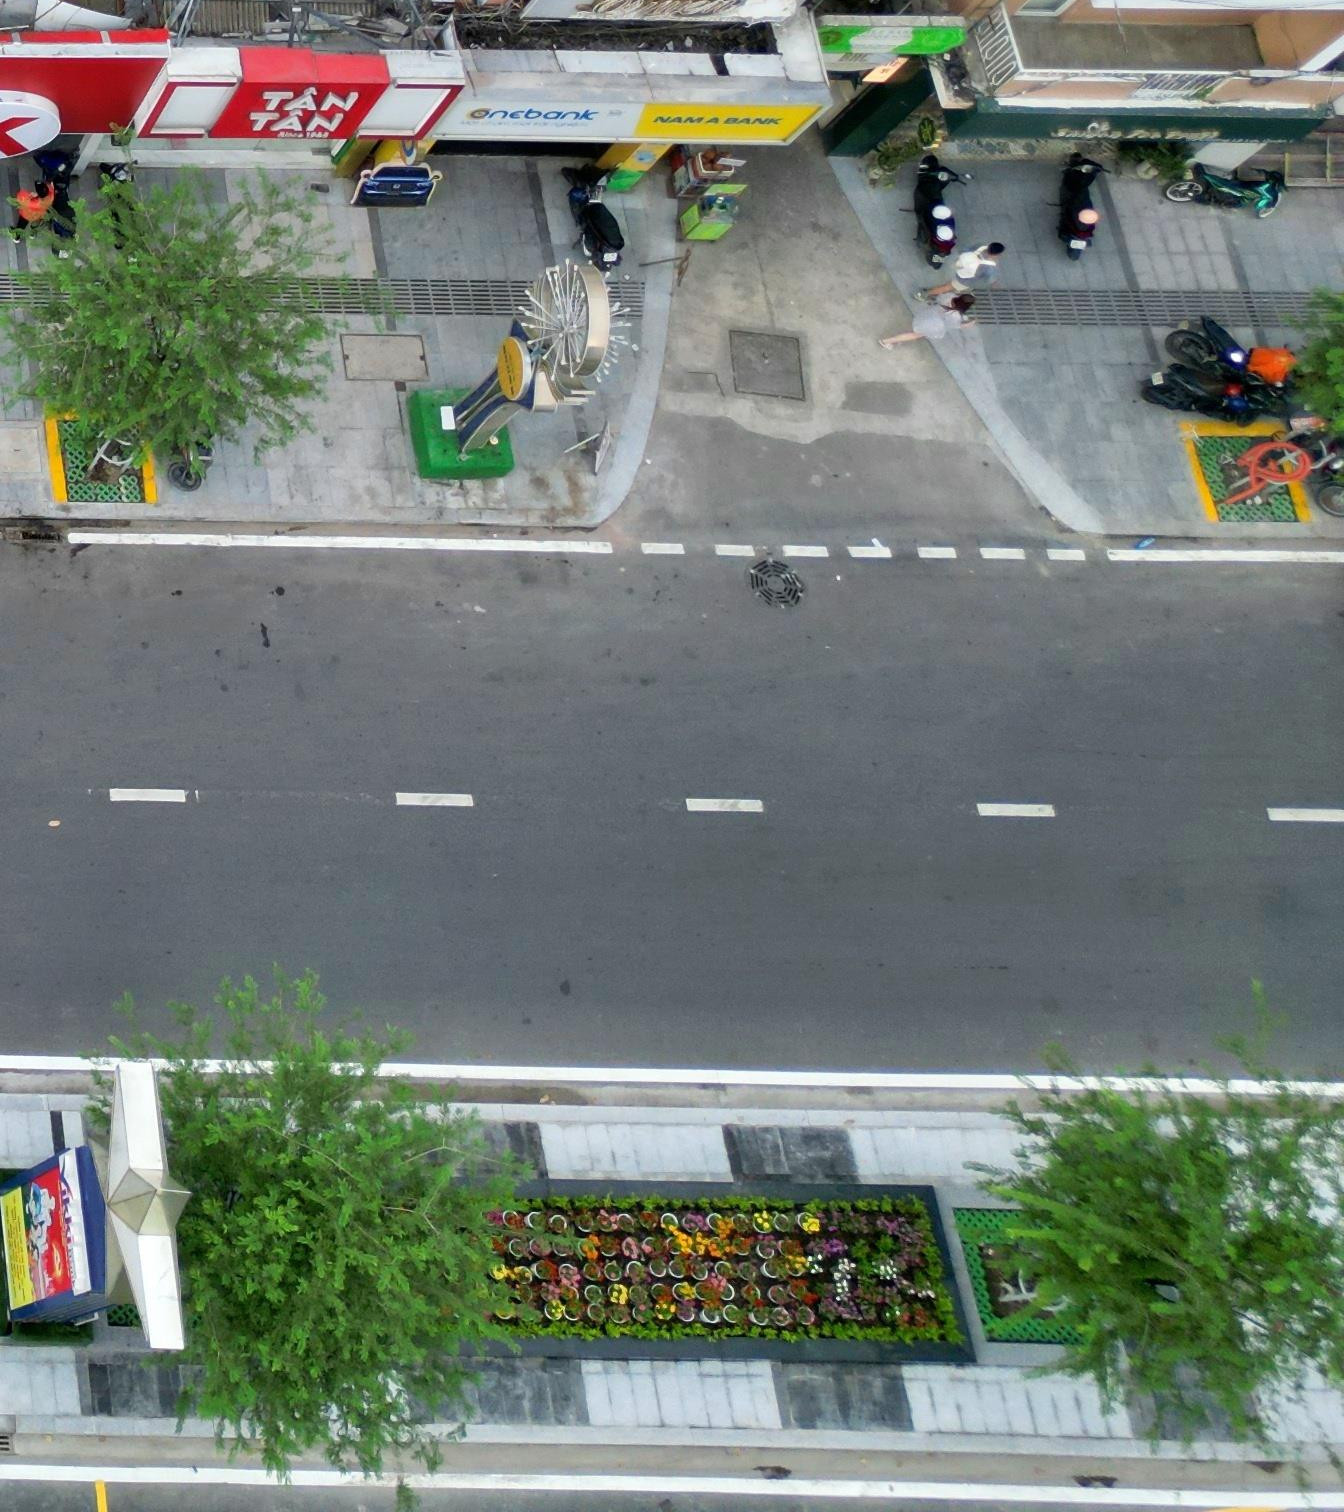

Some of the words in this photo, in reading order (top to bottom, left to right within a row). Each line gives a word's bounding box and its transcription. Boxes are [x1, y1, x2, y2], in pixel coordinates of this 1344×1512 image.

[262, 87, 359, 111] TÂN
[249, 109, 344, 132] TÂN
[653, 116, 703, 124] NAM
[722, 117, 783, 125] BANK
